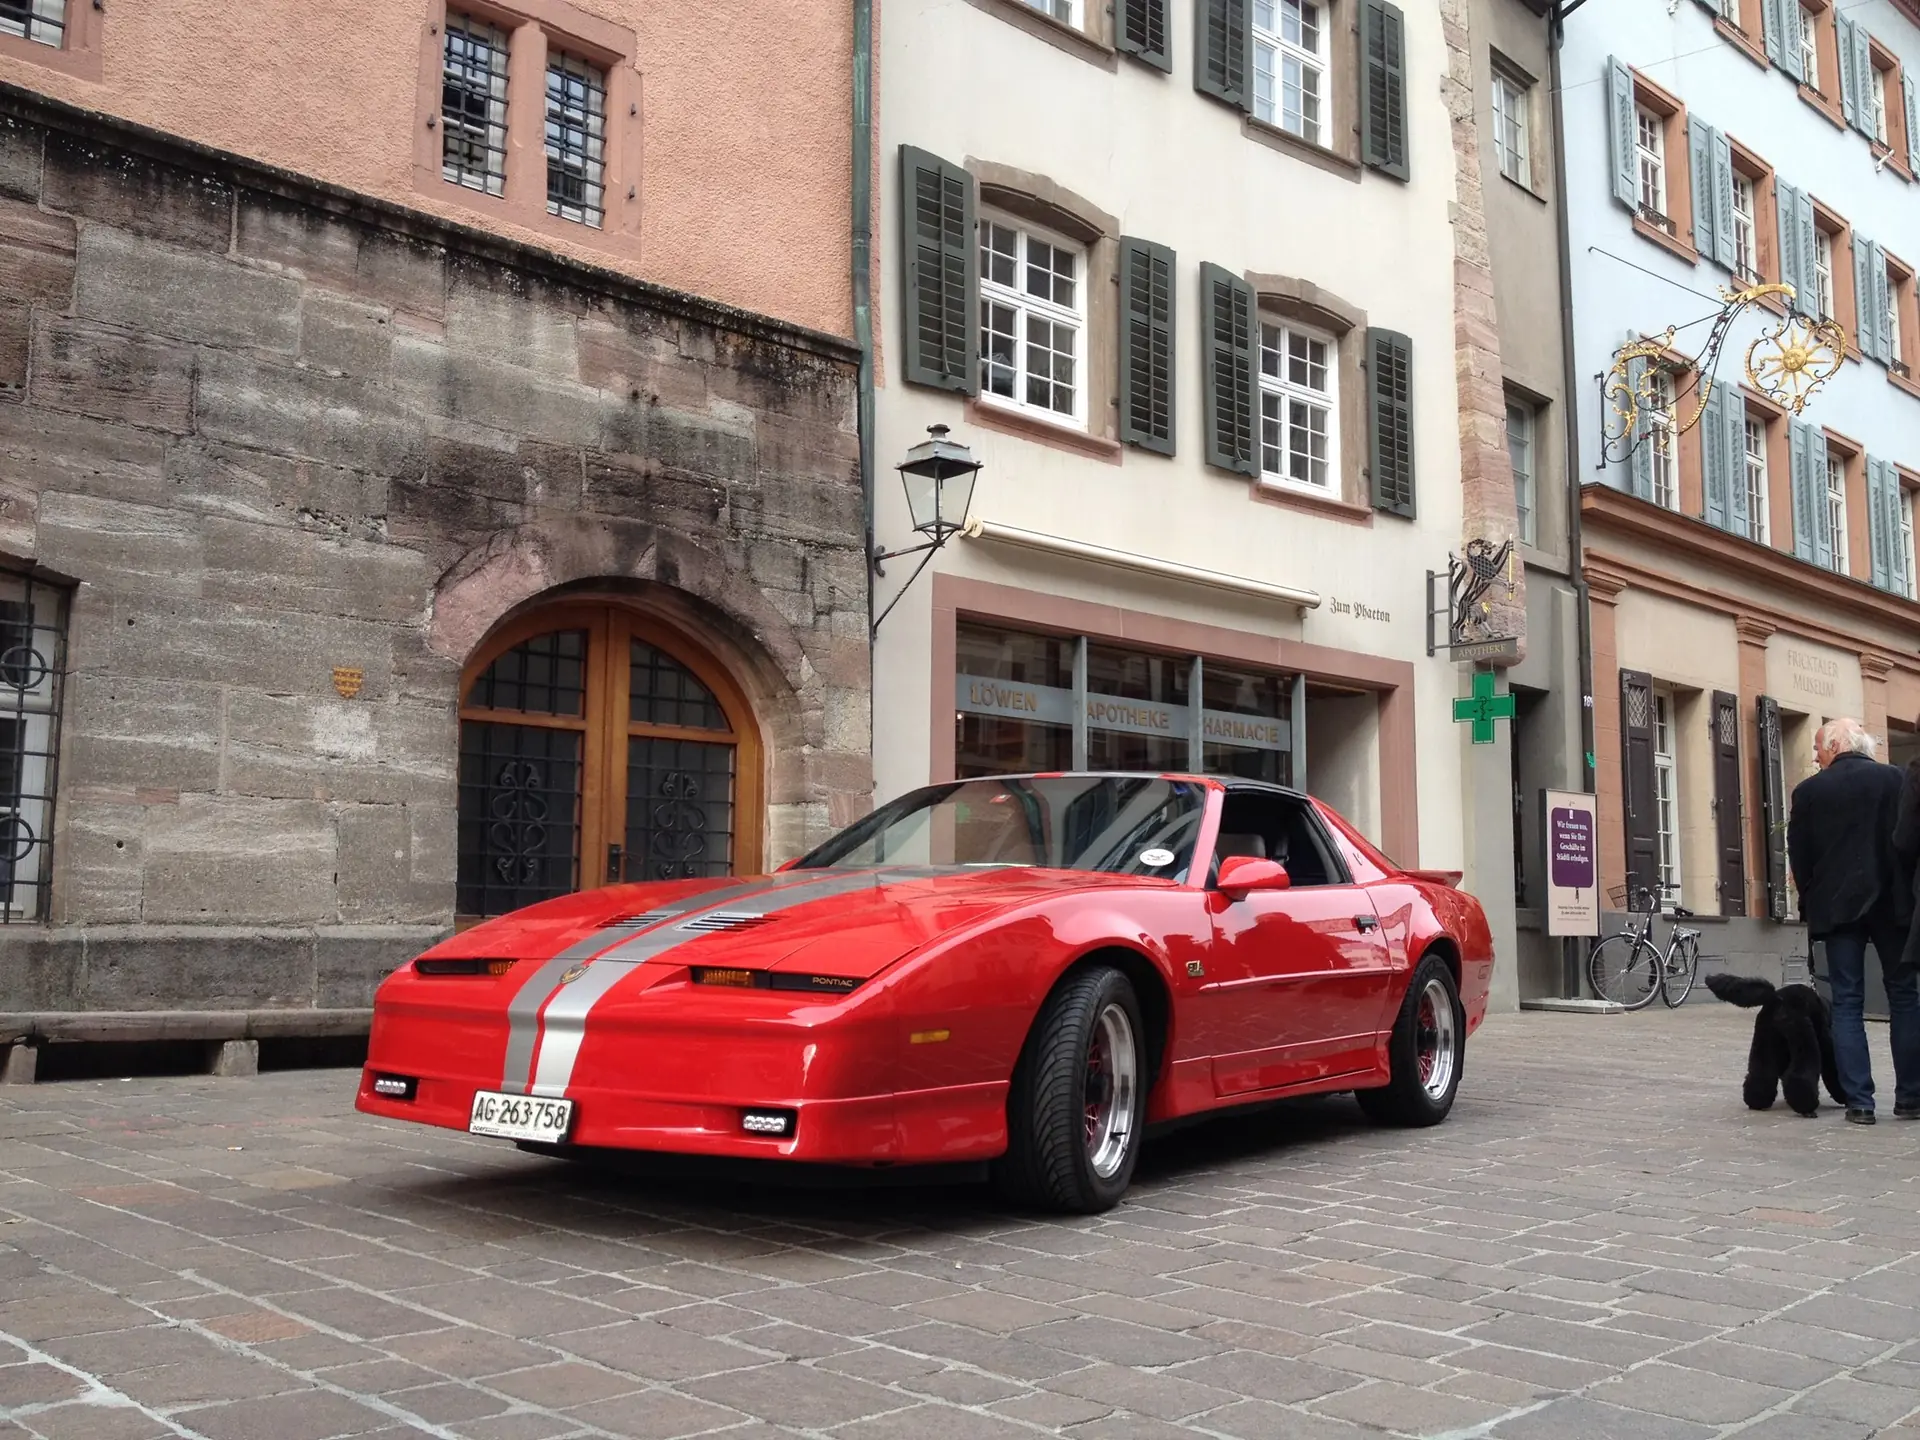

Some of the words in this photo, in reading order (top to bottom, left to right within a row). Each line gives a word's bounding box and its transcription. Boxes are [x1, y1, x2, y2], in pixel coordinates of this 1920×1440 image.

[1330, 596, 1350, 614] Zum
[1459, 644, 1506, 658] APOTHEKE
[1787, 649, 1839, 679] FRICKTALER
[1793, 672, 1835, 698] MUSEUM
[970, 681, 1038, 712] LÖWEN
[1087, 702, 1170, 730] APOTHEKE
[1203, 716, 1279, 744] HARMACIE
[812, 976, 853, 987] PONTIAC
